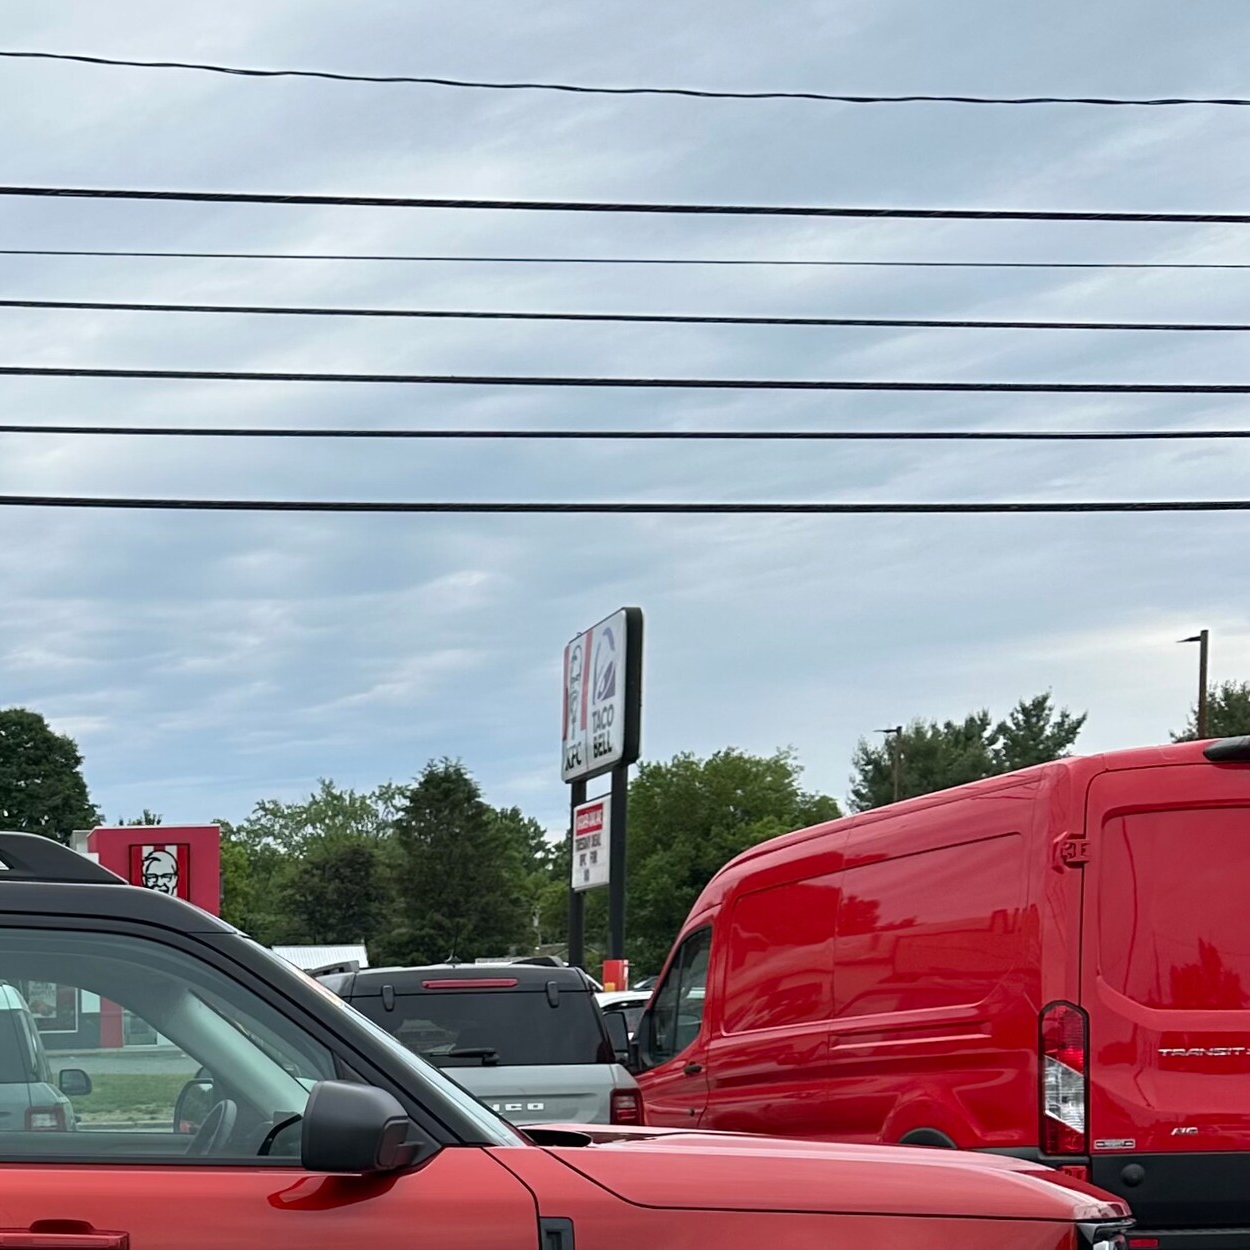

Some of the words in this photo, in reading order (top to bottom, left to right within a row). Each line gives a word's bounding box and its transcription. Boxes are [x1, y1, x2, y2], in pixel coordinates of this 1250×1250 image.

[592, 704, 614, 734] TACO
[565, 741, 581, 771] KFC
[593, 730, 613, 758] BELL
[1158, 1047, 1245, 1056] TRANSIT
